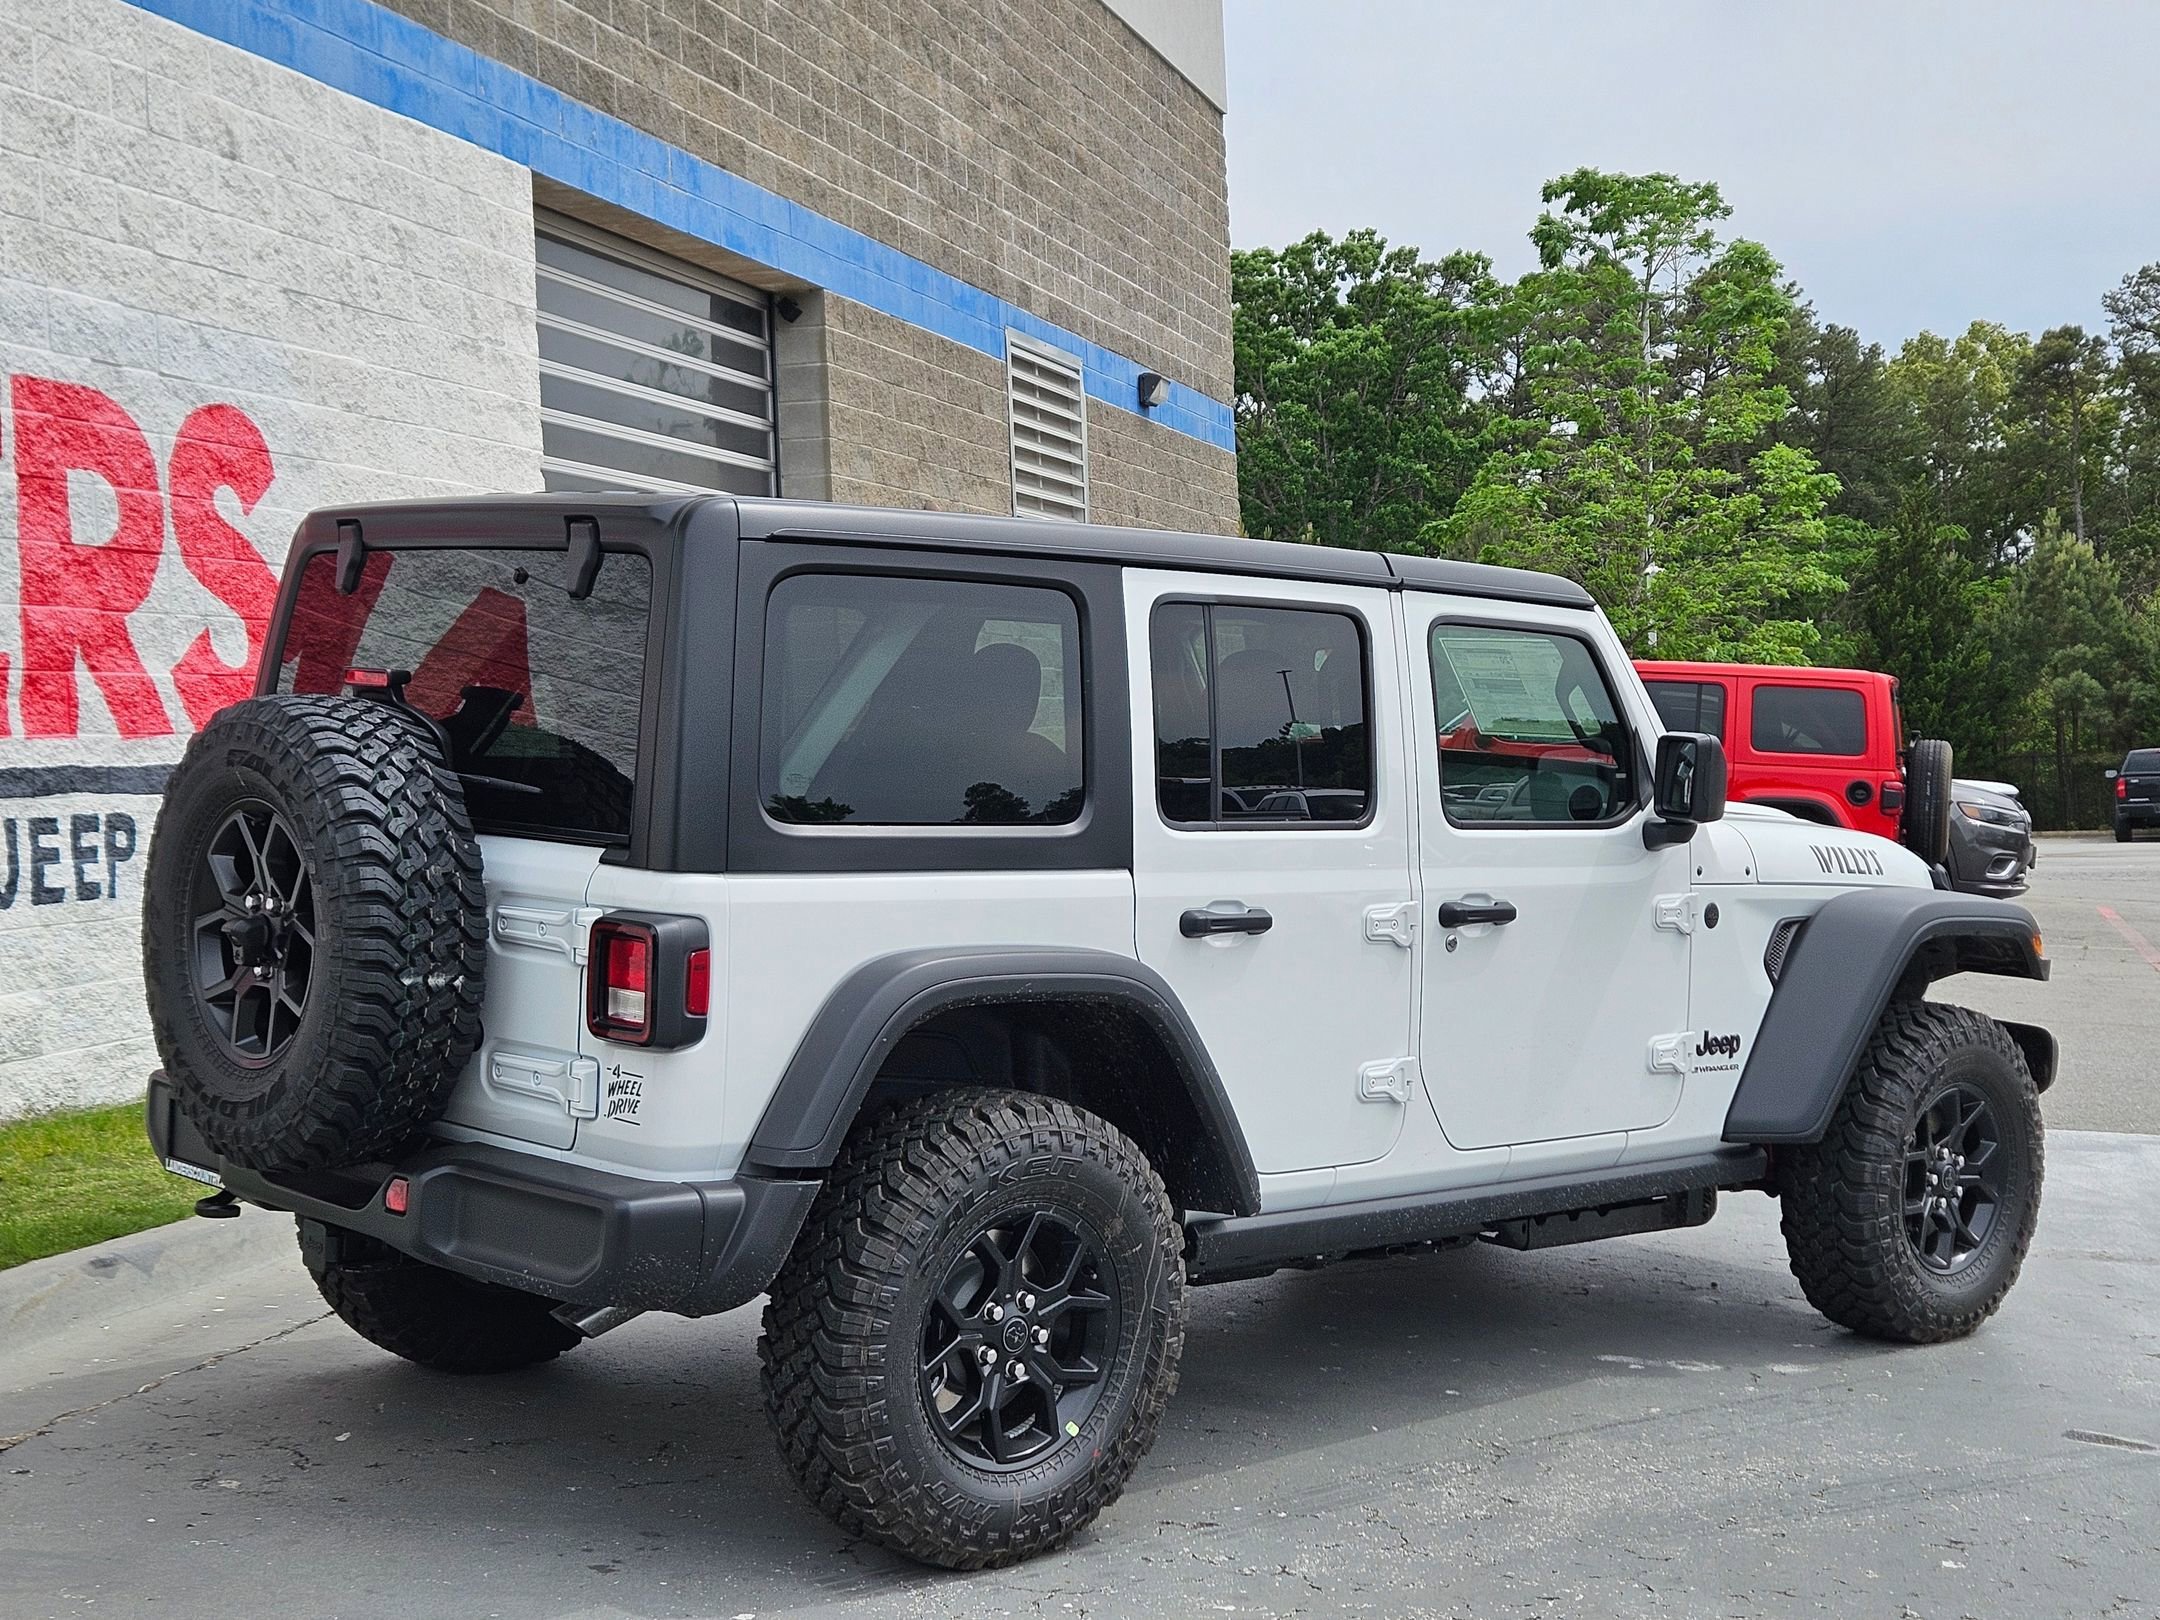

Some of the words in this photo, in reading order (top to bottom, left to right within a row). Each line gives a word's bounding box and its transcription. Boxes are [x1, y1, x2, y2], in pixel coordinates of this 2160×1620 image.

[0, 373, 280, 741] RS
[1695, 1029, 1741, 1060] Jeep
[1699, 1063, 1740, 1073] WRANGLER
[607, 1079, 643, 1098] WHEEL
[606, 1097, 642, 1119] DRIVE
